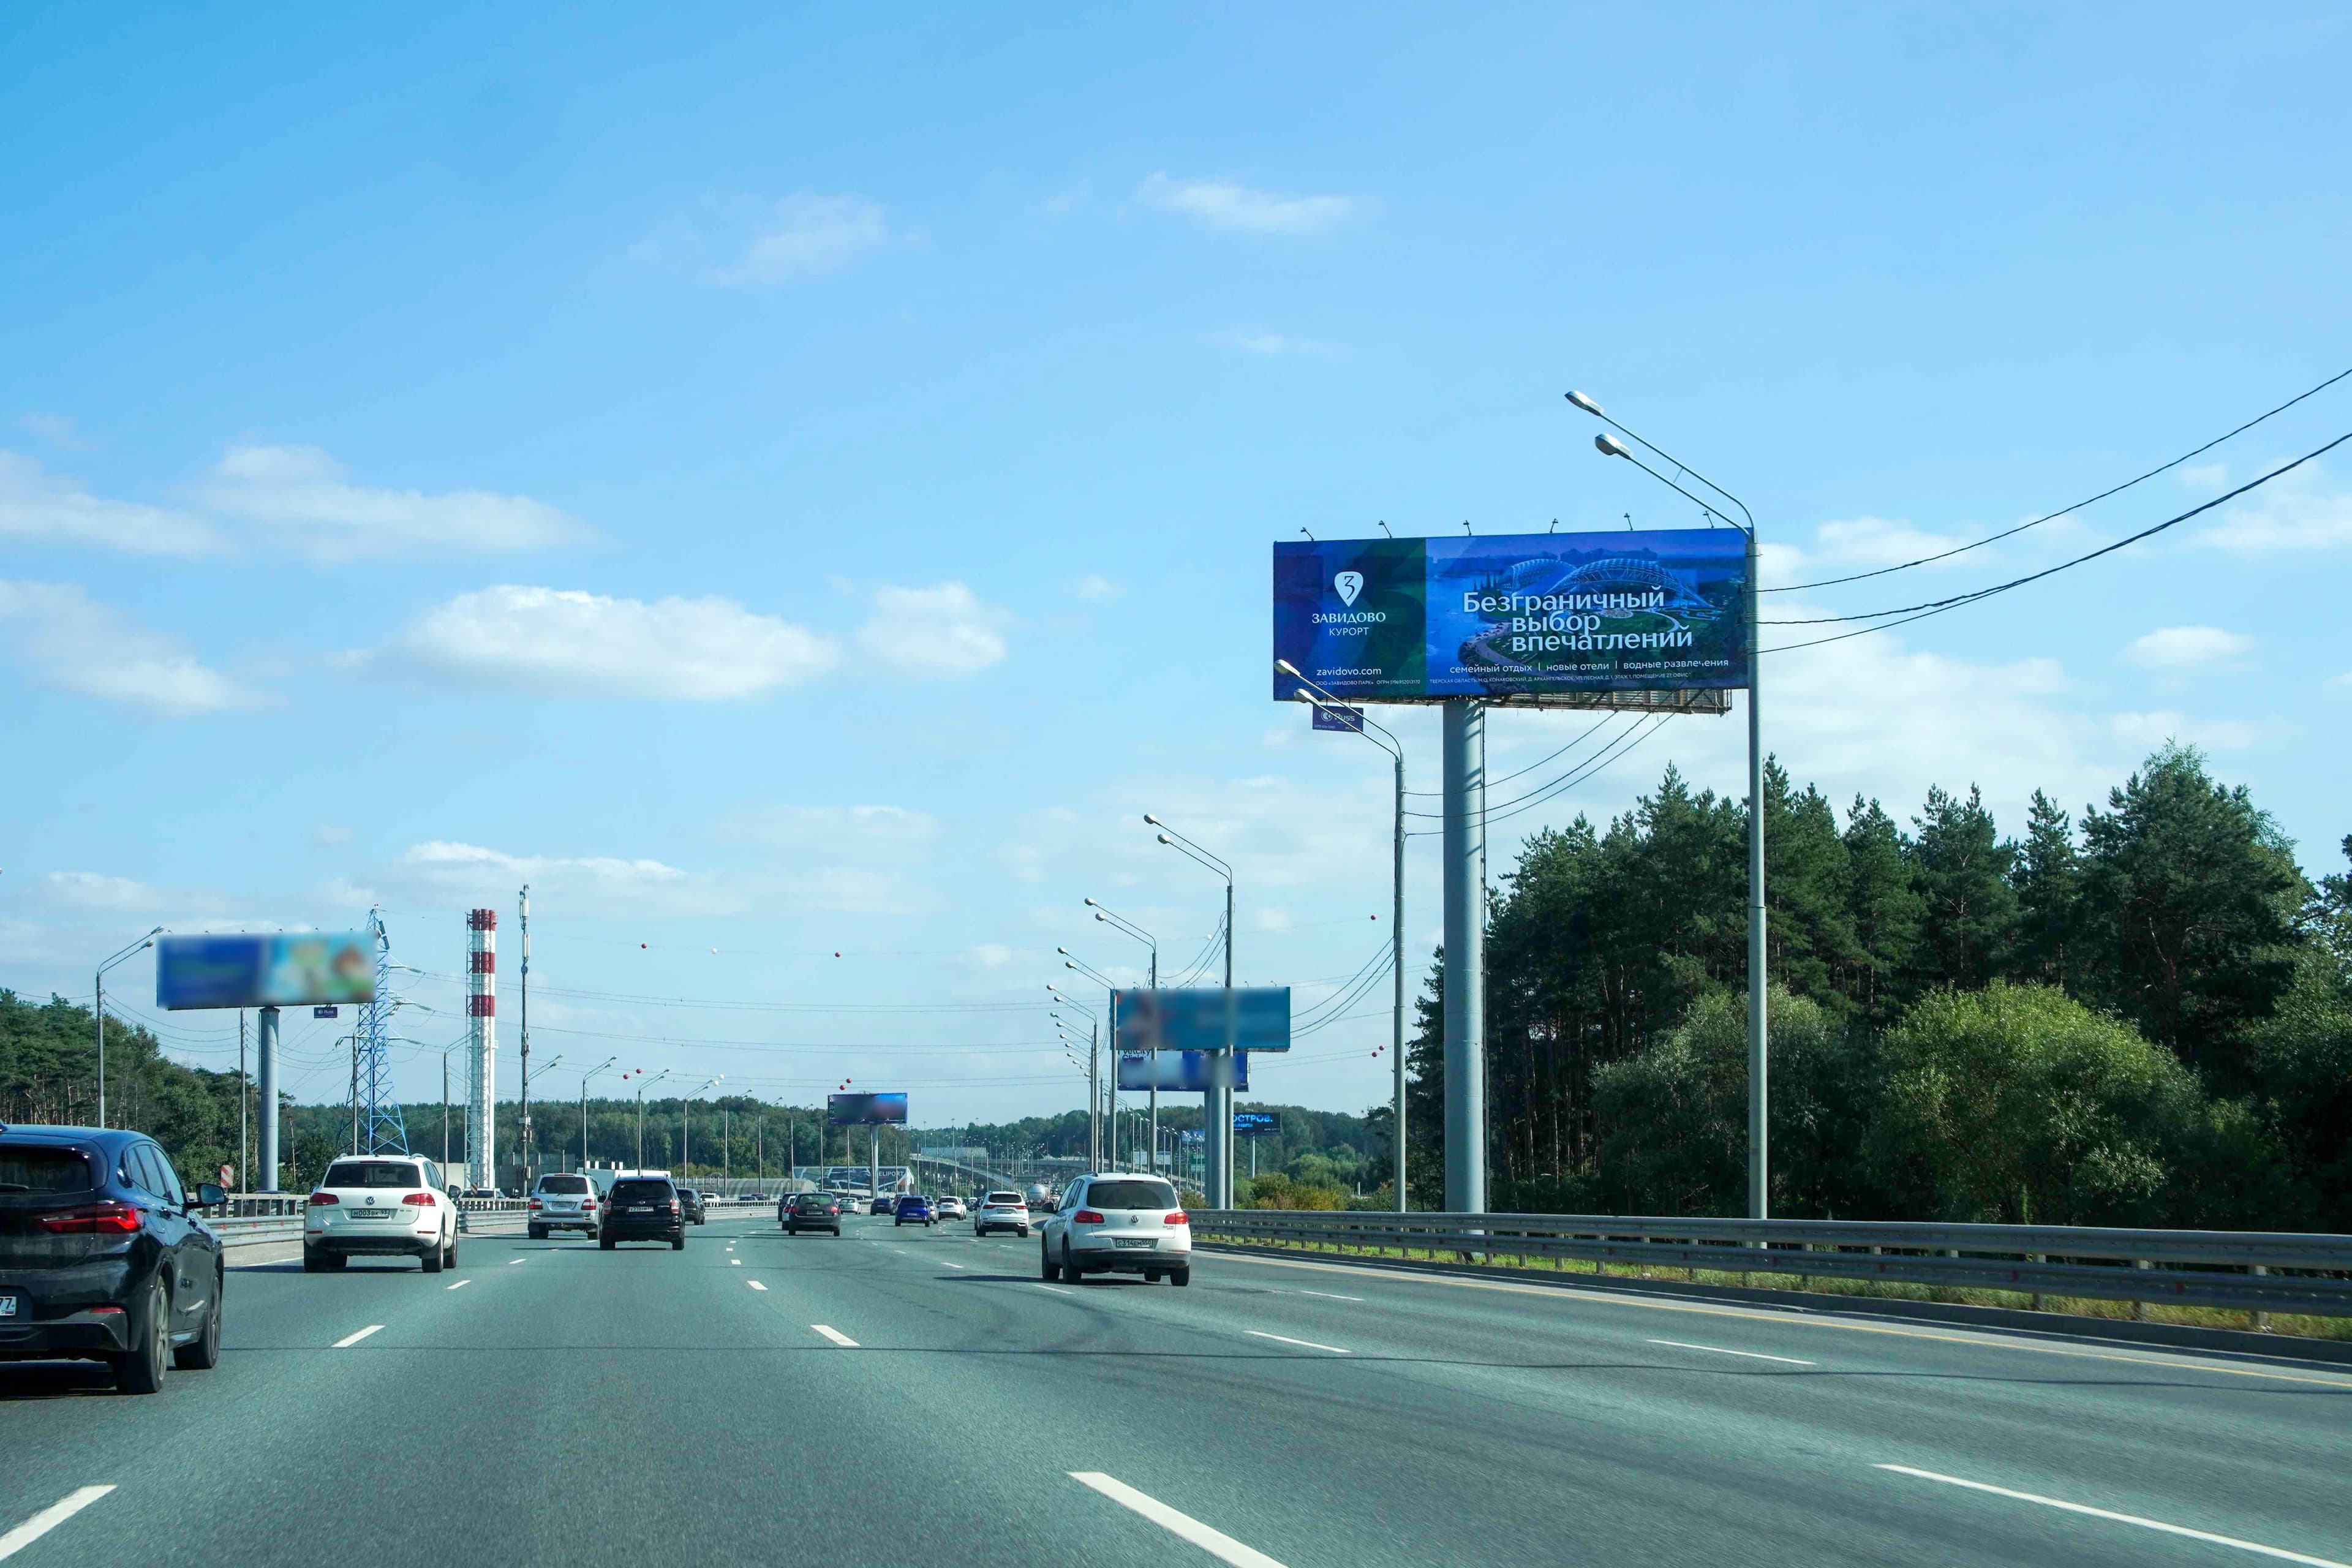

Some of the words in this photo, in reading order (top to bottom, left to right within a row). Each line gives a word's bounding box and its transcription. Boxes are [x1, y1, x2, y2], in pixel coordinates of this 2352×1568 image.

[1463, 585, 1665, 616] Безграничный
[1312, 612, 1386, 624] ЗАВИДОВО
[1512, 610, 1601, 636] выбор
[1329, 627, 1370, 636] КУРОРТ
[1512, 624, 1693, 652] впечатлений
[1316, 667, 1382, 676] zavidovo.com
[1449, 663, 1500, 674] семейный
[1623, 661, 1662, 669] водные
